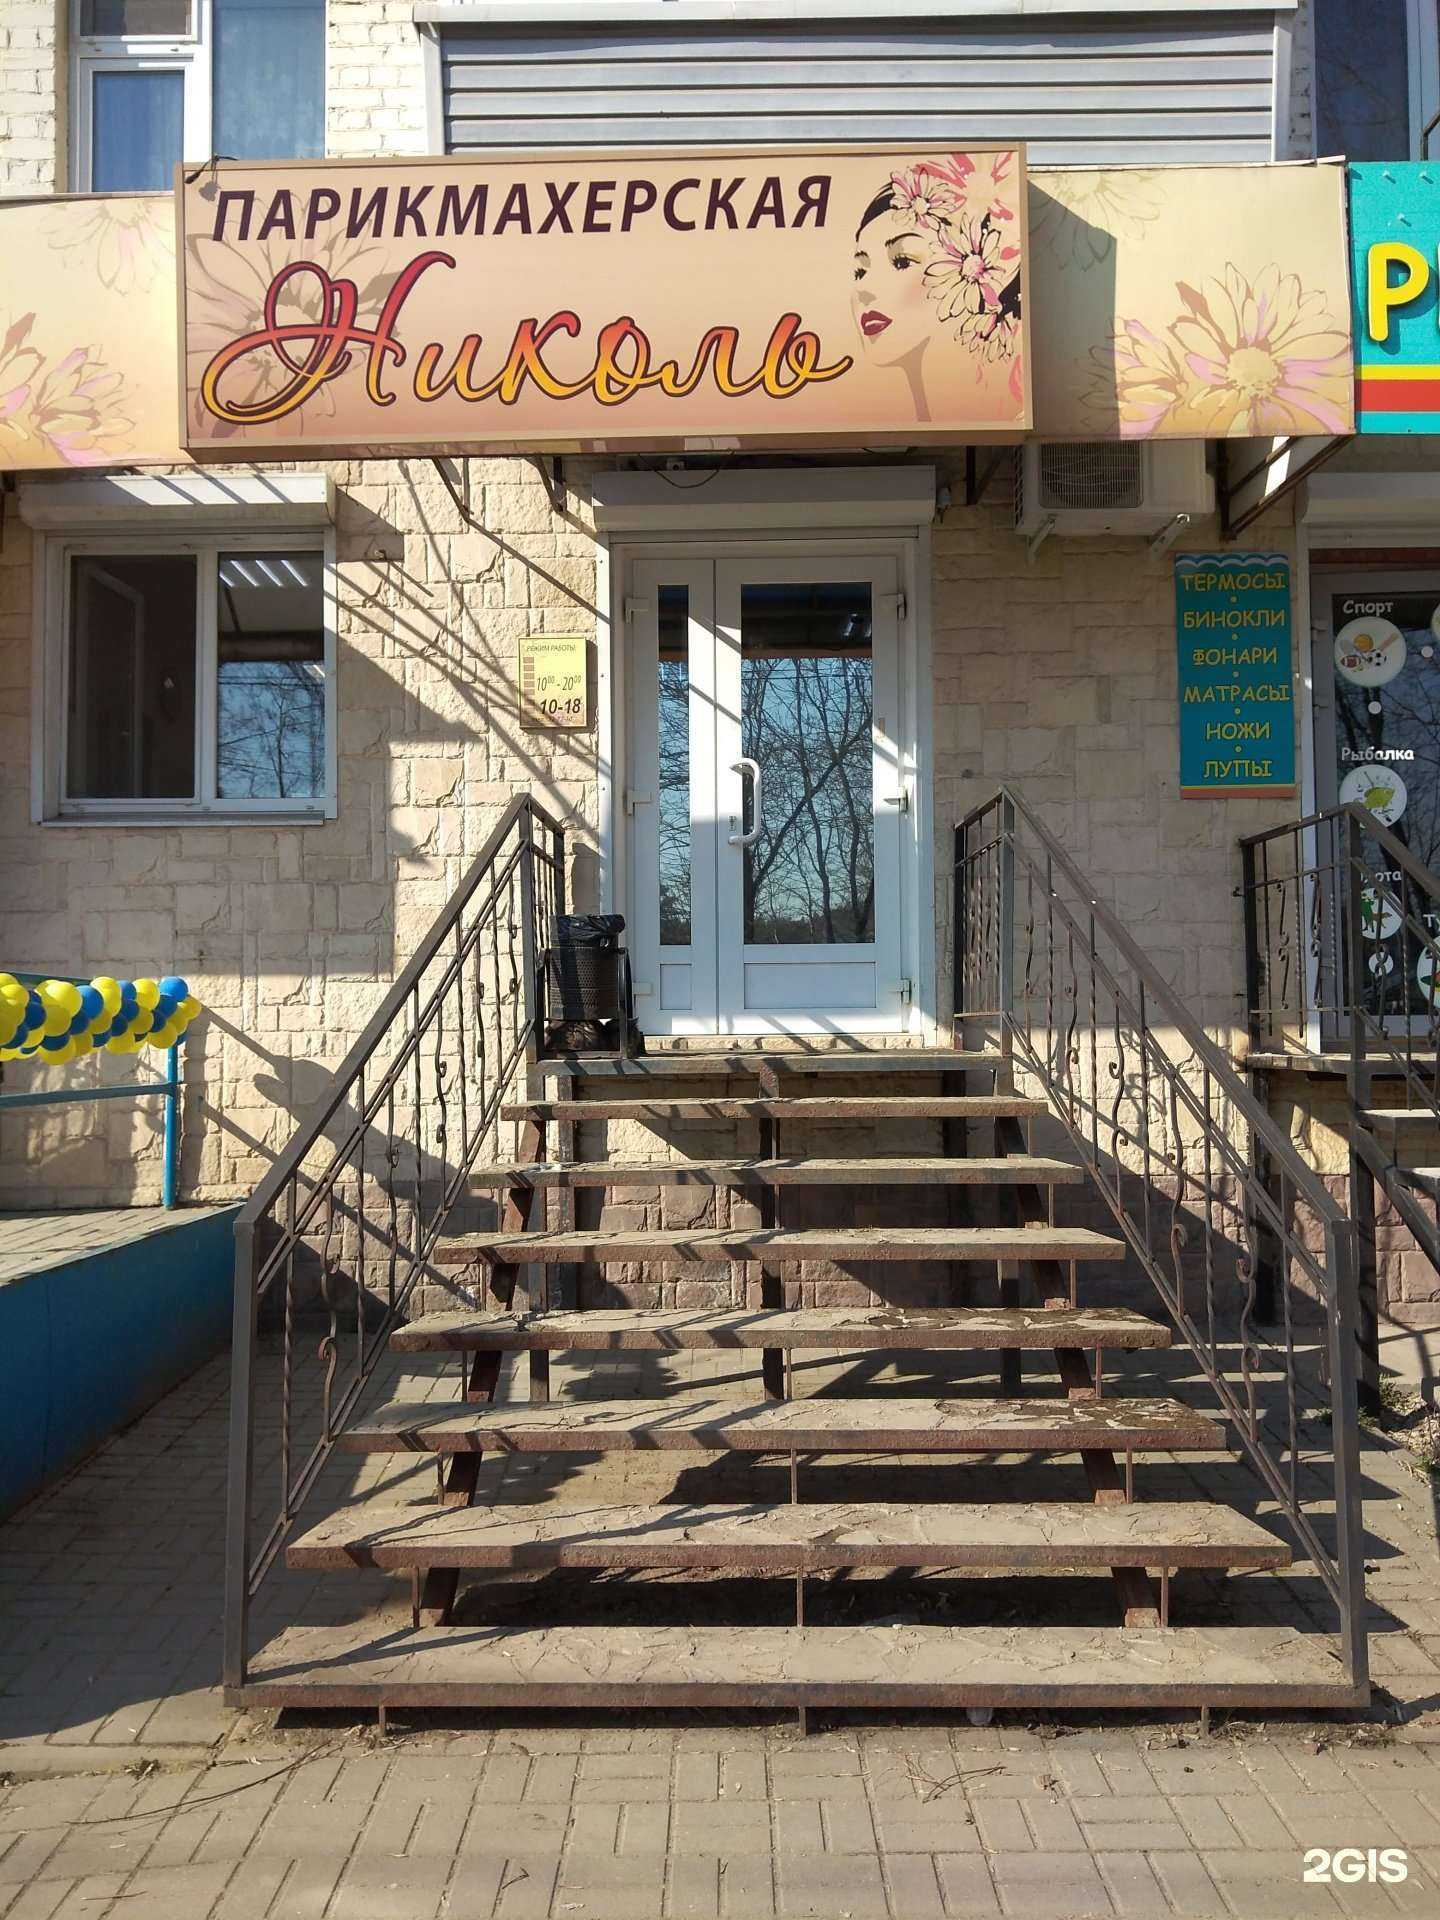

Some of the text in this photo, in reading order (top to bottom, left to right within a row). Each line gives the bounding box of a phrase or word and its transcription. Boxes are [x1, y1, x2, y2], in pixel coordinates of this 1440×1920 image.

[212, 175, 832, 241] ПАРИКМАХЕРСКАЯ
[1367, 241, 1440, 342] Р
[202, 250, 854, 425] Николь
[1180, 572, 1287, 592] ТЕРМОСЫ
[1342, 600, 1394, 616] Спорт
[1183, 610, 1285, 629] БИНОКЛИ
[1192, 647, 1277, 666] ФОНАРИ
[1184, 684, 1290, 704] МАТРАСЫ
[540, 698, 581, 714] 10-18
[1205, 722, 1271, 740] НОЖИ
[1341, 747, 1415, 762] Рыбалка
[1203, 759, 1272, 778] ЛУПЫ
